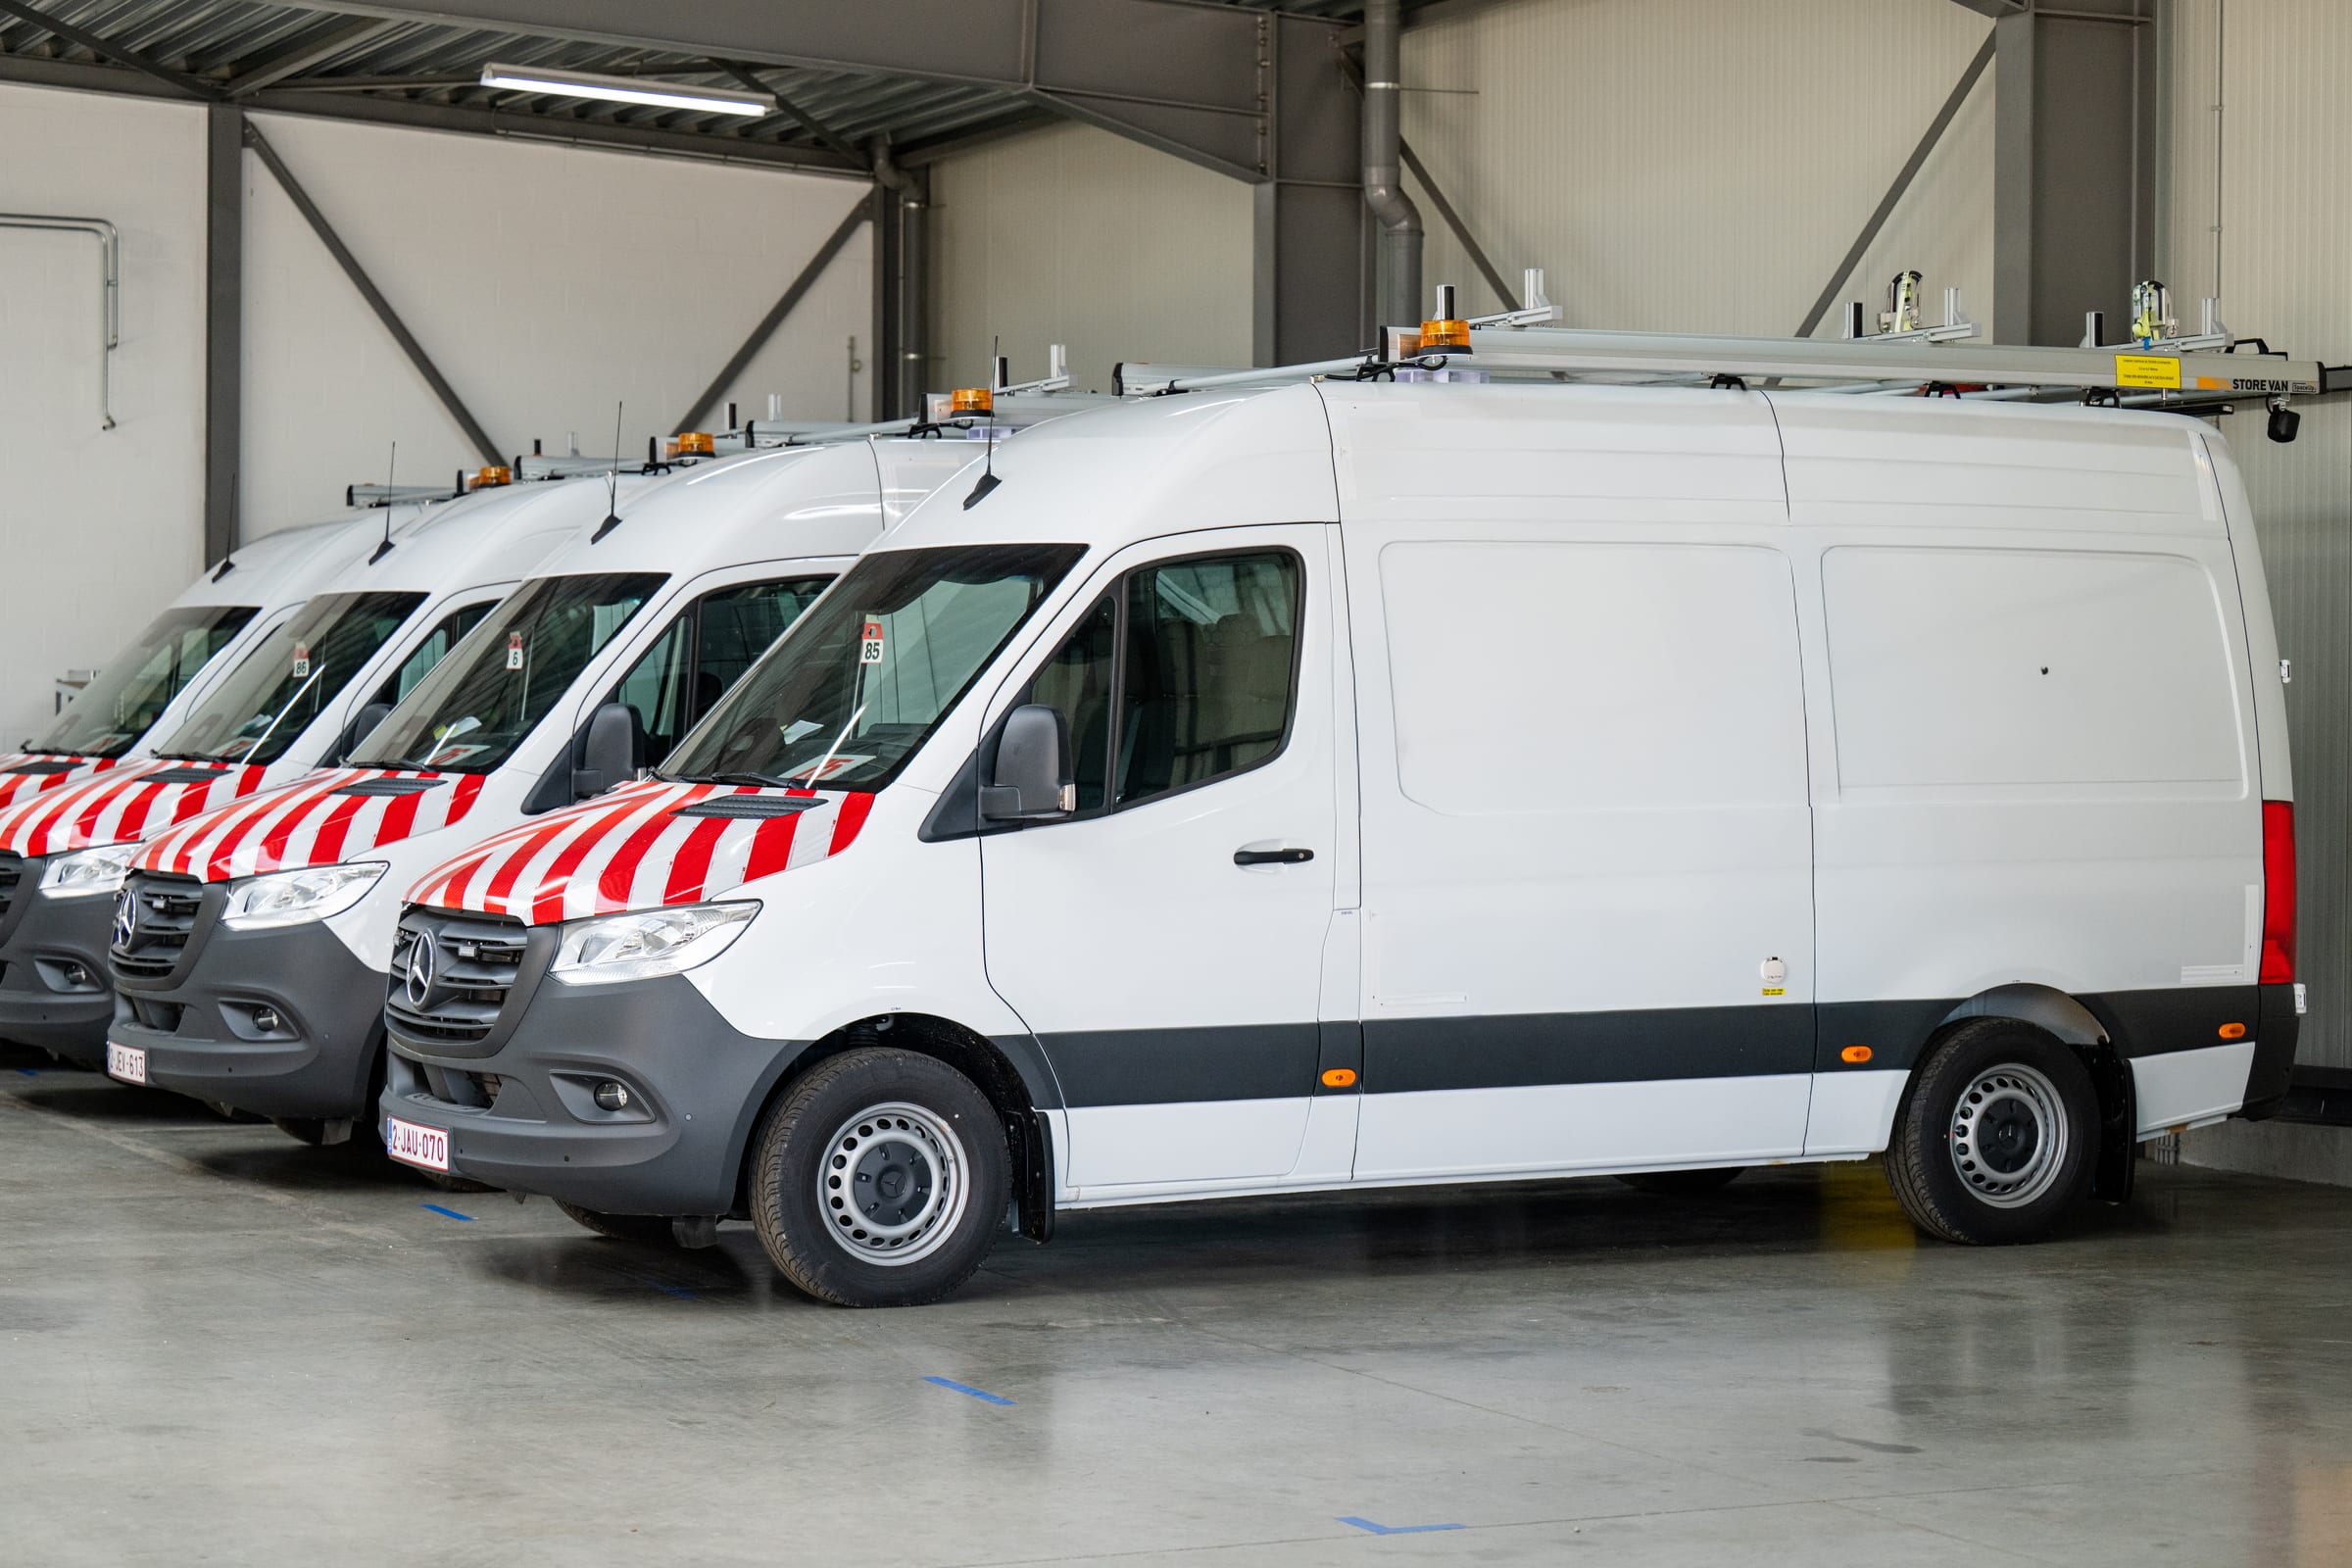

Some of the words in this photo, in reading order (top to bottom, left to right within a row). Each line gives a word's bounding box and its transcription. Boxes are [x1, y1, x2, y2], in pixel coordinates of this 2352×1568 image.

[2232, 378, 2267, 391] STORE
[2268, 379, 2288, 392] VAN
[513, 651, 518, 666] 6
[864, 642, 880, 661] 85
[296, 661, 307, 674] 86
[392, 1123, 445, 1162] 2-JAU-070
